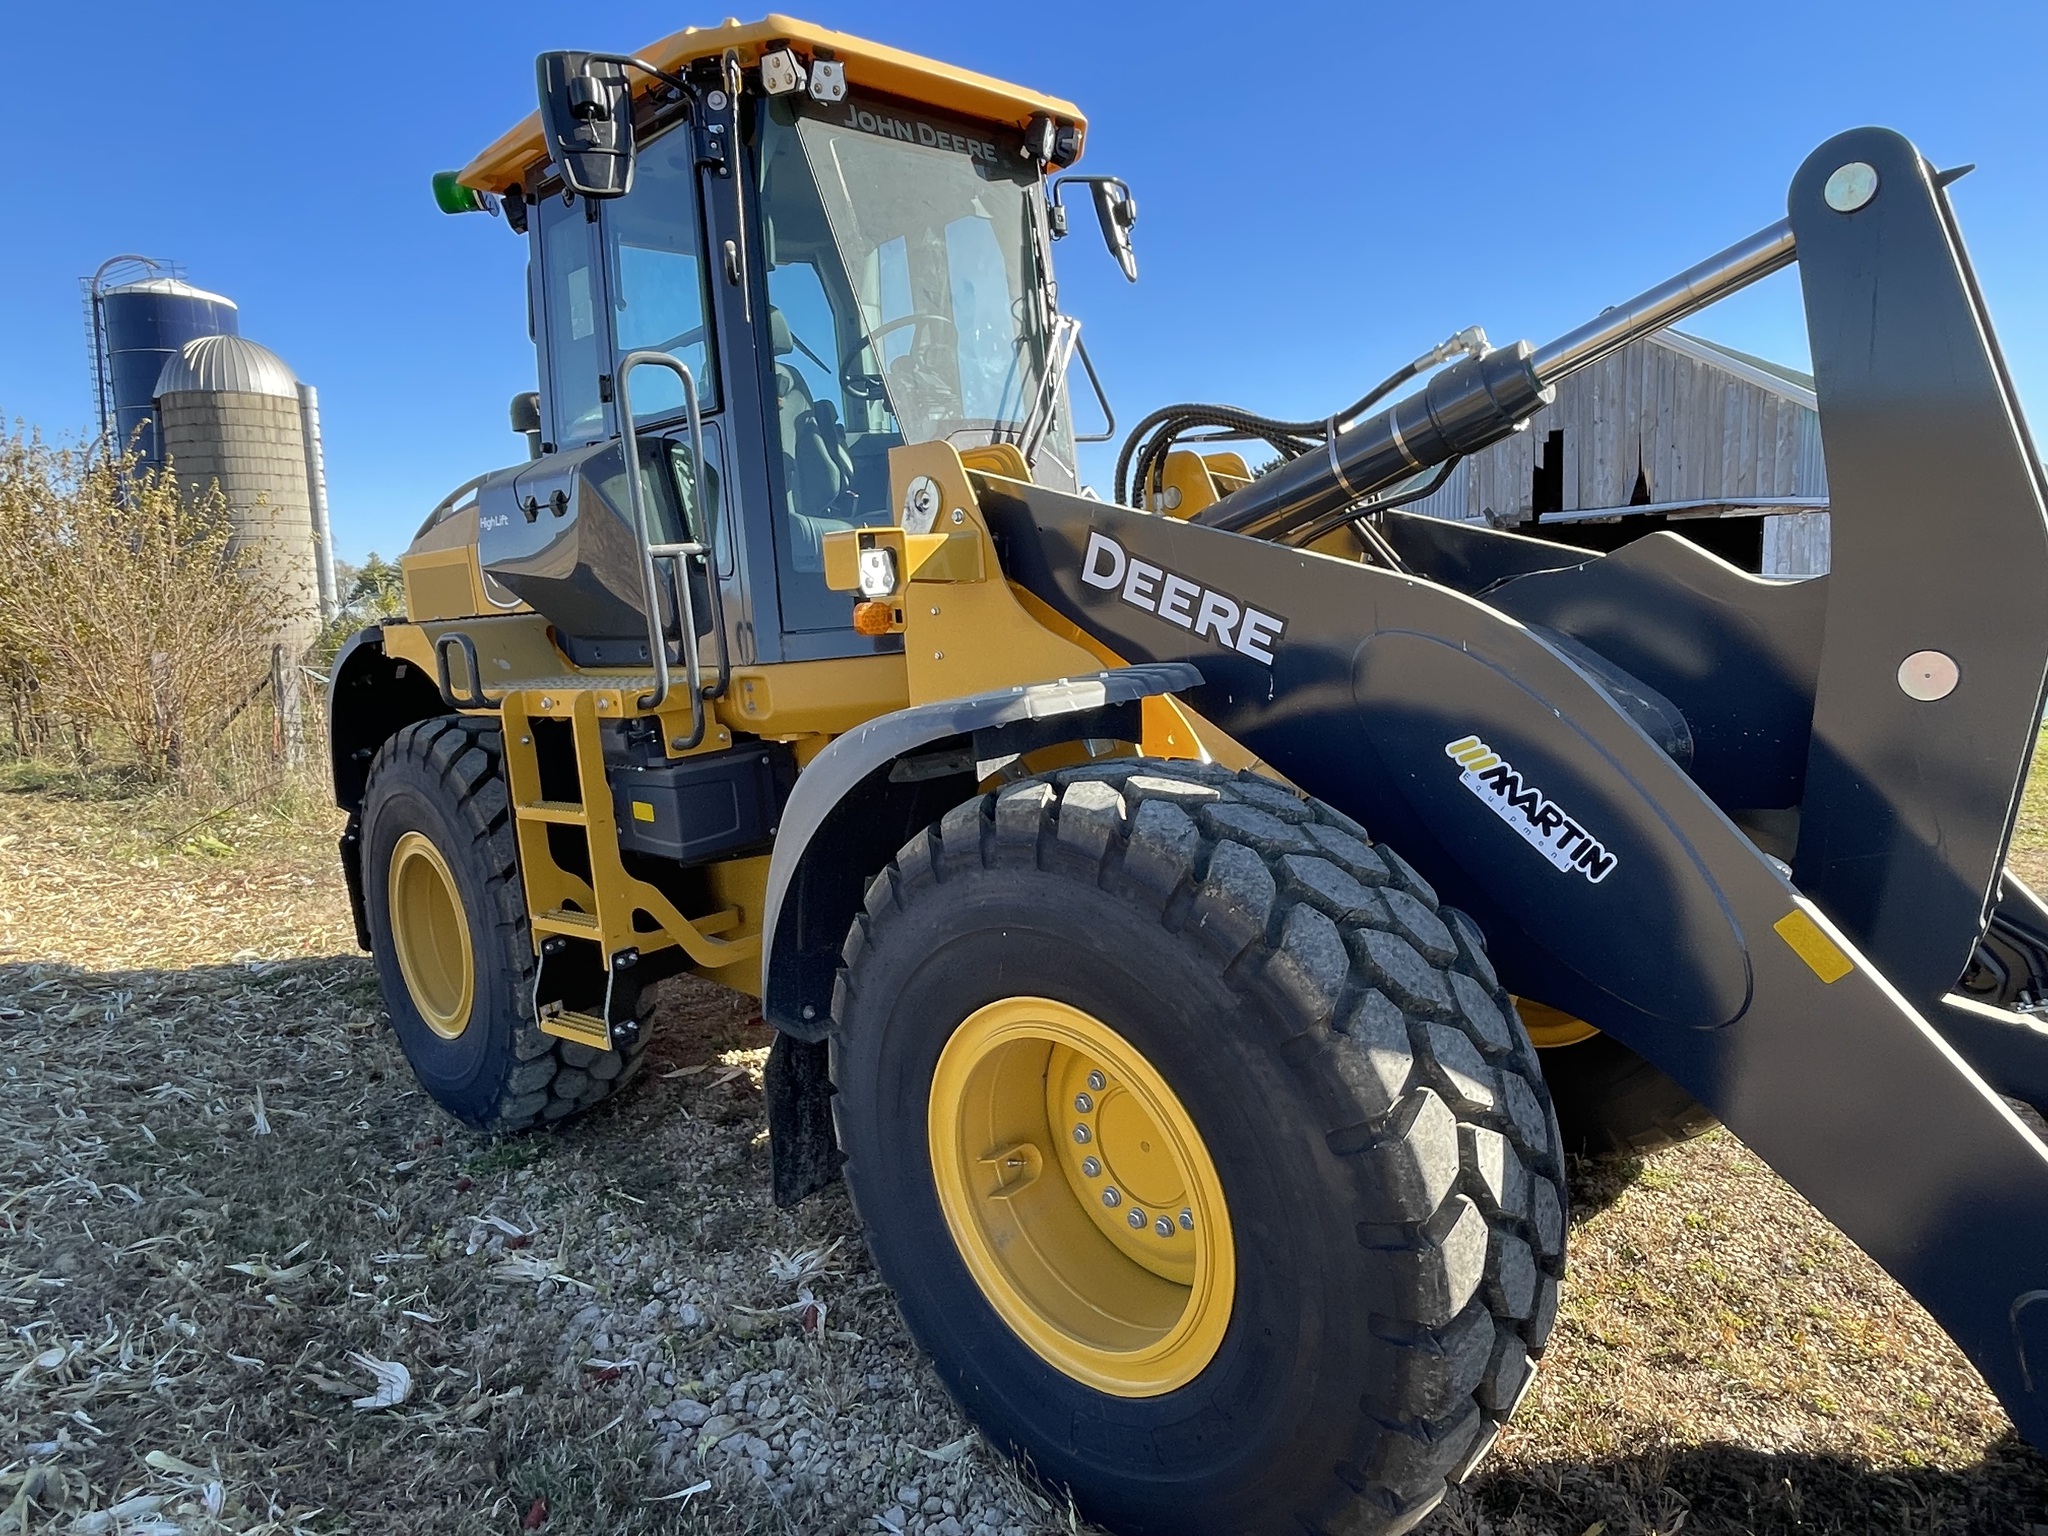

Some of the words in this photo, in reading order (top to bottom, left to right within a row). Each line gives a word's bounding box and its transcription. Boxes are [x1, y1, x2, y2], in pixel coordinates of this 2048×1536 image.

[843, 104, 914, 142] JOHN
[917, 121, 998, 163] DEERE
[1081, 531, 1284, 666] DEERE
[1463, 772, 1570, 869] Equipment
[1478, 765, 1614, 880] MARTIN
